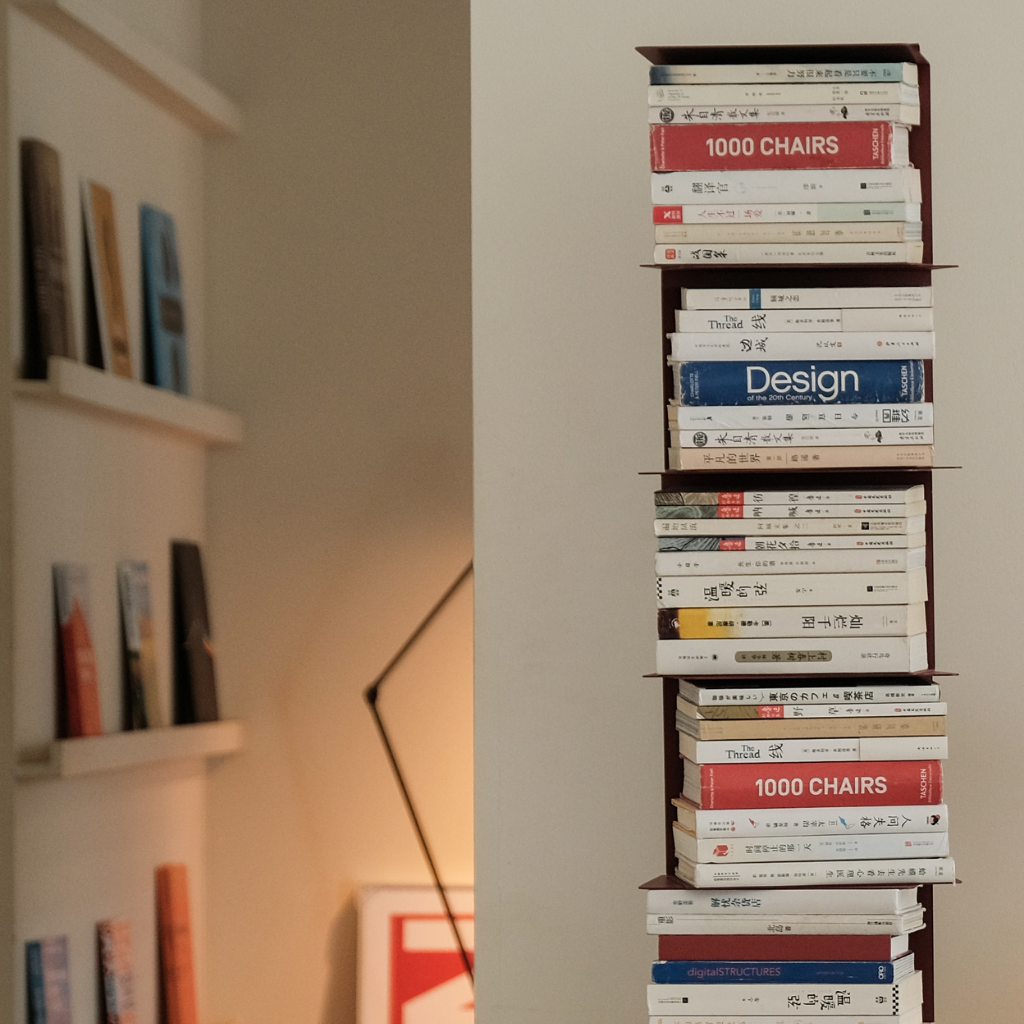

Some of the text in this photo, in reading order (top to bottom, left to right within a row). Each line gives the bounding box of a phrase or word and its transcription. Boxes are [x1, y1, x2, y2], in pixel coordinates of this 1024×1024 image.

[681, 108, 760, 122] 朱自清散文集
[705, 135, 840, 157] 1000 CHAIRS
[692, 182, 729, 194] 翻译官
[770, 295, 800, 303] 倾城之恋
[708, 320, 744, 330] Thread
[751, 314, 767, 329] 线
[740, 337, 768, 352] 边城
[746, 365, 859, 401] Design
[785, 412, 859, 421] 今日宜远游
[714, 432, 794, 446] 朱自清散文集
[703, 453, 761, 464] 平凡的世界
[753, 493, 799, 504] 彷徨
[752, 506, 799, 518] 呐喊
[661, 522, 698, 532] 遍地风流
[755, 540, 800, 551] 朝花夕拾
[704, 581, 768, 602] 温暖的弦
[802, 614, 863, 629] 灿烂千阳
[787, 652, 828, 661] 村上春树
[793, 706, 839, 717] 野草
[726, 749, 761, 759] Thread
[768, 743, 783, 759] 线
[755, 776, 888, 797] 1000 CHAIRS
[803, 814, 912, 829] 人间失格 太宰治
[745, 843, 812, 854] 时间停止的那一天
[826, 867, 927, 878] 蛤蟆先生去看心理医生
[710, 898, 762, 908] 解忧杂货店
[687, 967, 782, 979] digitalSTRUCTURES
[787, 989, 851, 1011] 温暖的弦
